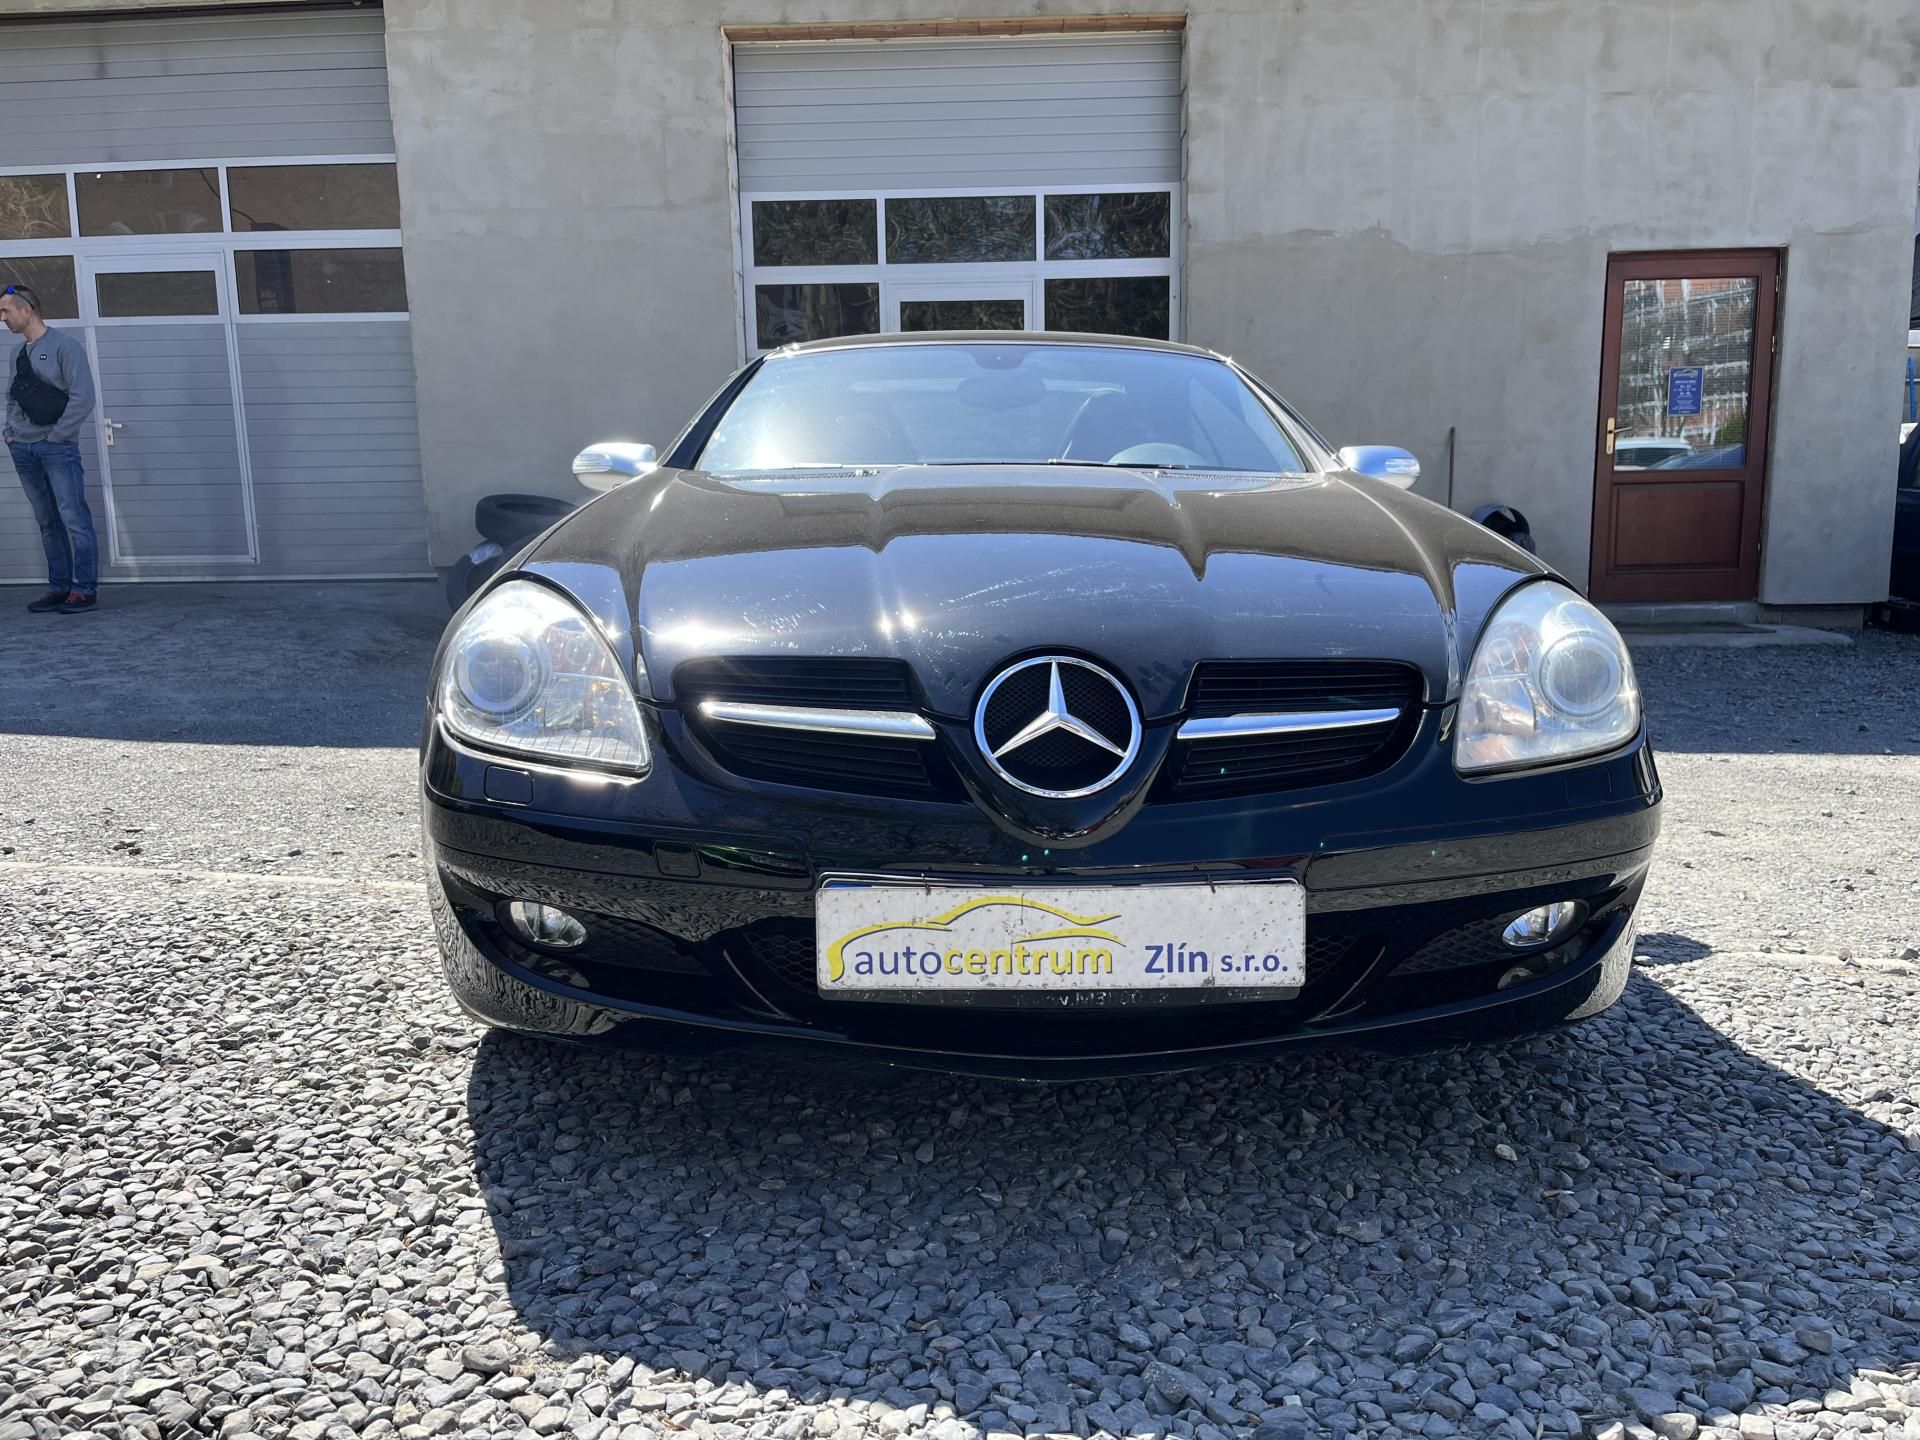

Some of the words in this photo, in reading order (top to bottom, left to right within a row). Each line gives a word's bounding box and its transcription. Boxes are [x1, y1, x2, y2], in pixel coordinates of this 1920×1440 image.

[854, 945, 1113, 975] autocentrum
[1144, 942, 1208, 974] Zlín
[1220, 953, 1288, 973] s.r.o.
